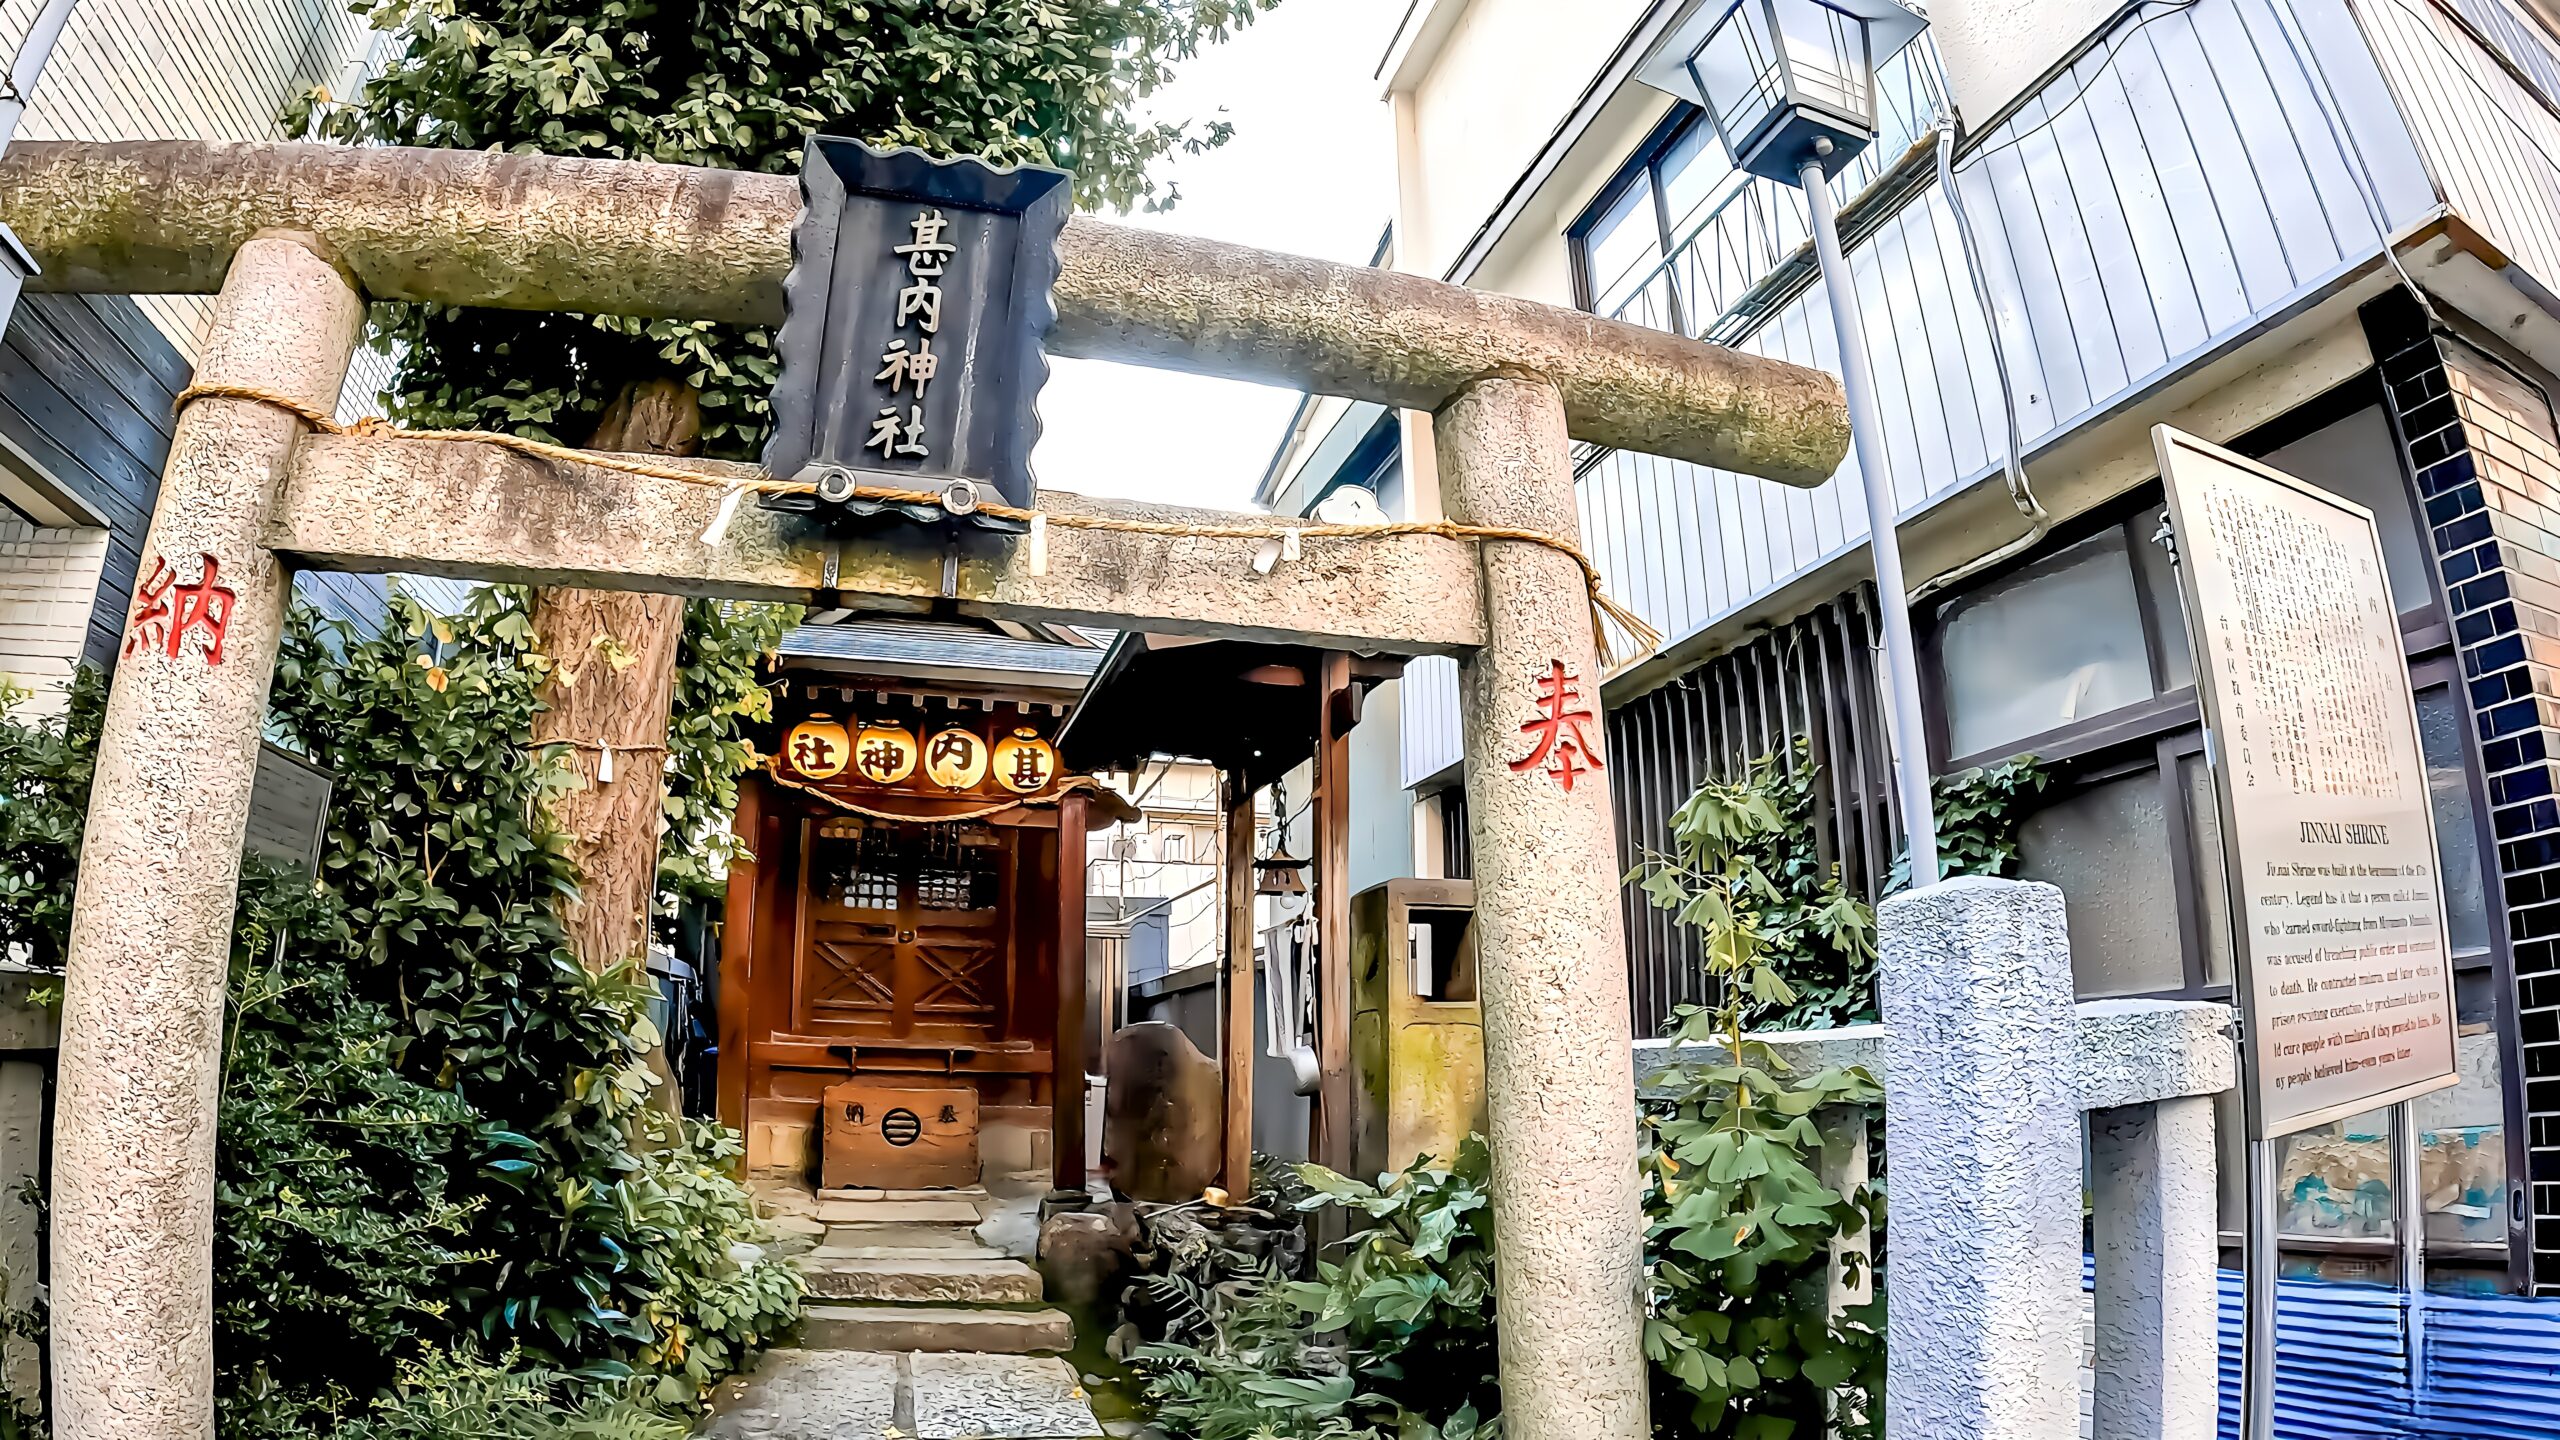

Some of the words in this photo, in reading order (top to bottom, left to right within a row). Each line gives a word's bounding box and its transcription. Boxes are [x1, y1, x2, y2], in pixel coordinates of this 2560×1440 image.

[865, 208, 957, 460] 甚内神社
[122, 551, 236, 667] 納
[1507, 657, 1605, 793] 奉
[2300, 821, 2342, 844] JINNAI
[2345, 823, 2390, 845] SHRINE
